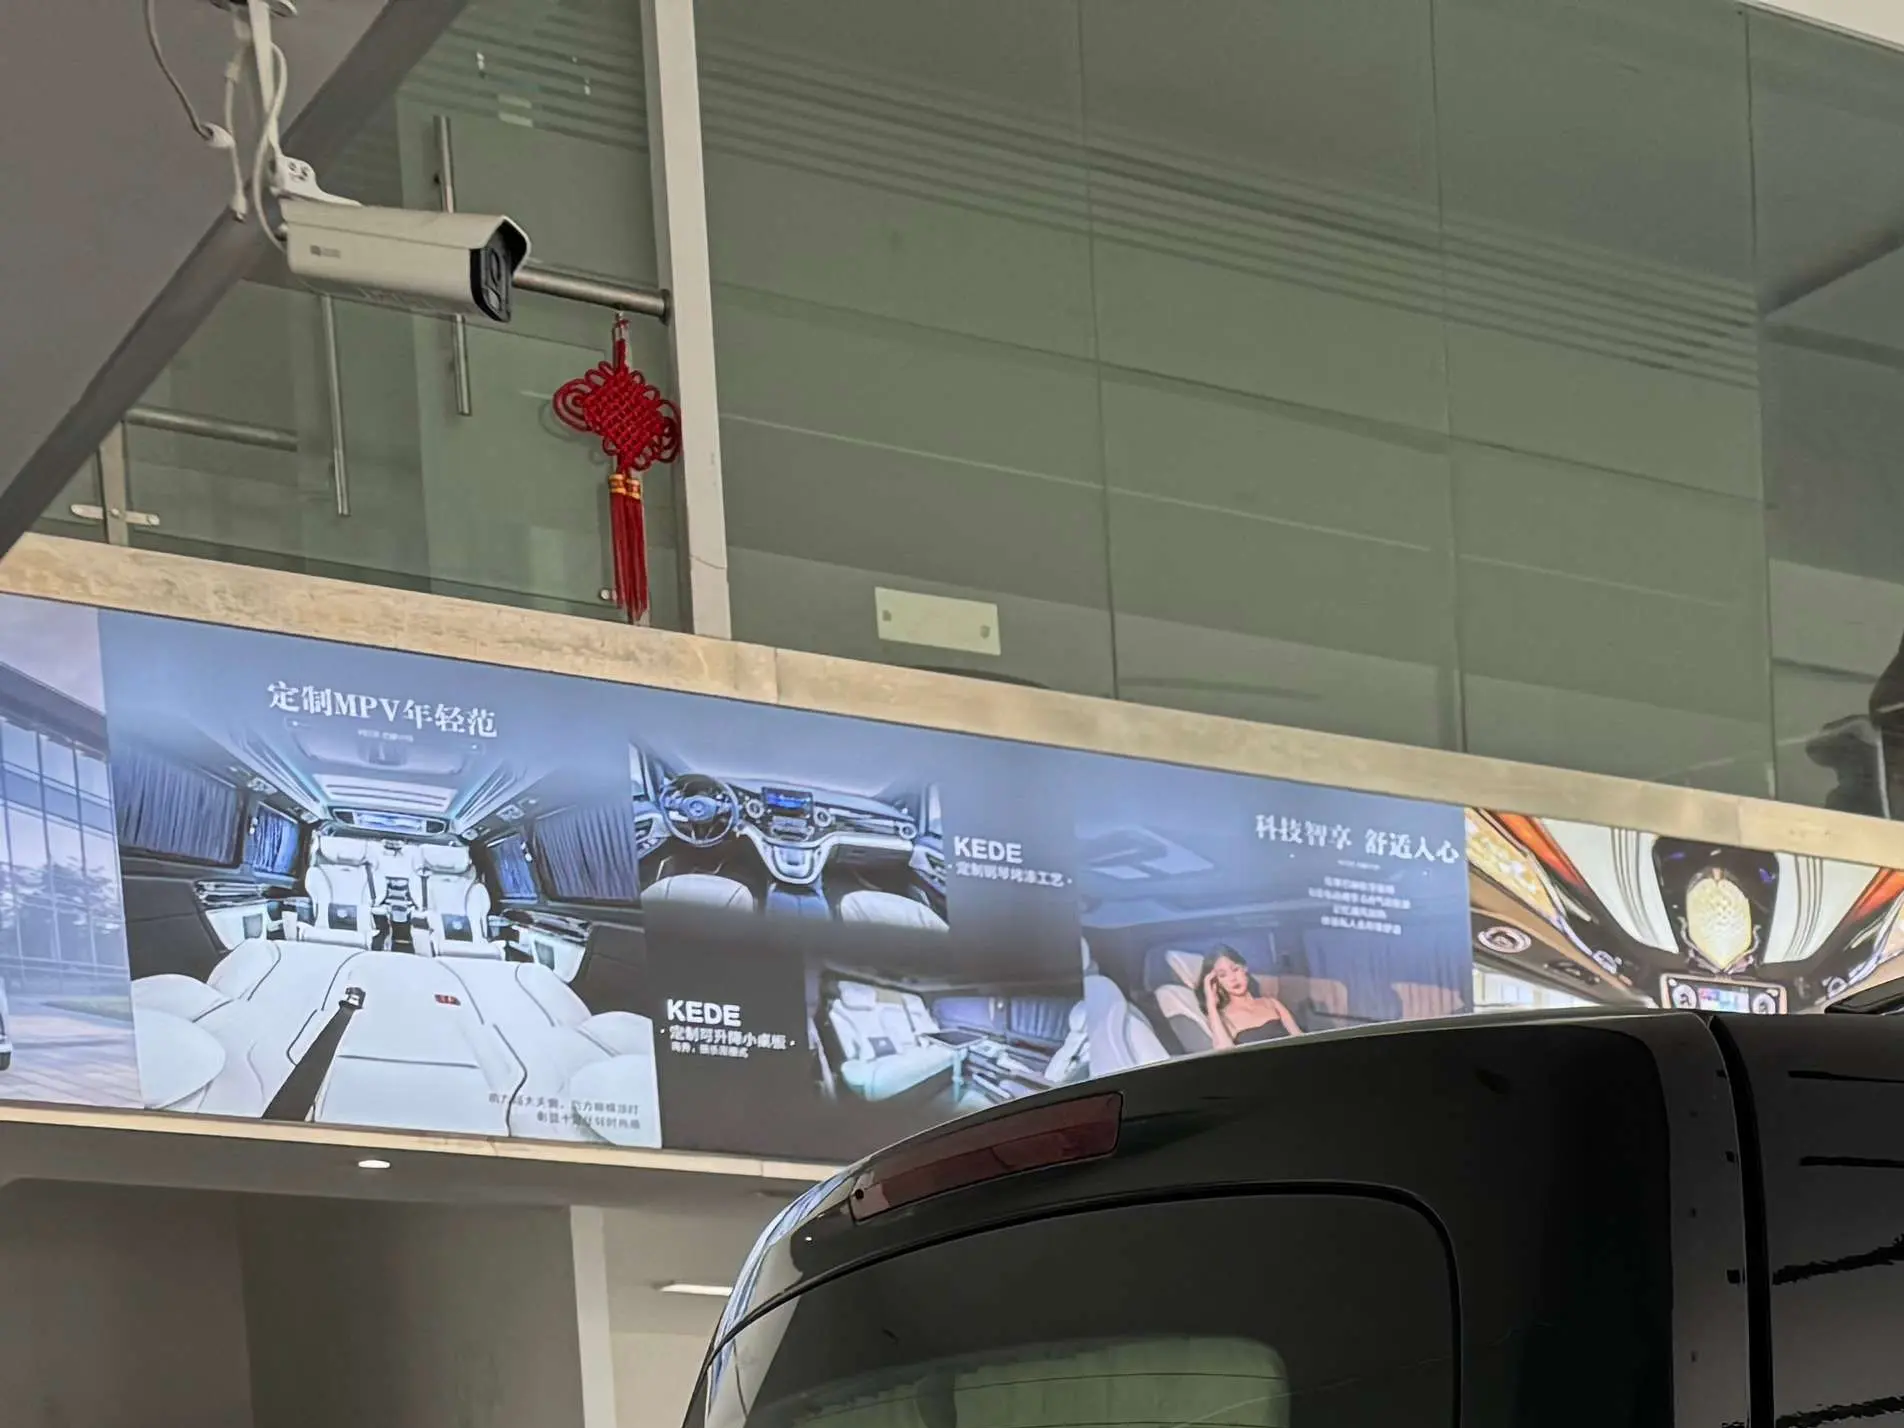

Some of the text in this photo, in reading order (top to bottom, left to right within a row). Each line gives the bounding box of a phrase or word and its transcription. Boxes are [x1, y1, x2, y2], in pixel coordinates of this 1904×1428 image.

[267, 681, 497, 738] 定制MPV年轻范
[954, 836, 1023, 864] KEDE
[1365, 828, 1460, 864] 舒适人心
[667, 999, 742, 1027] KEDE
